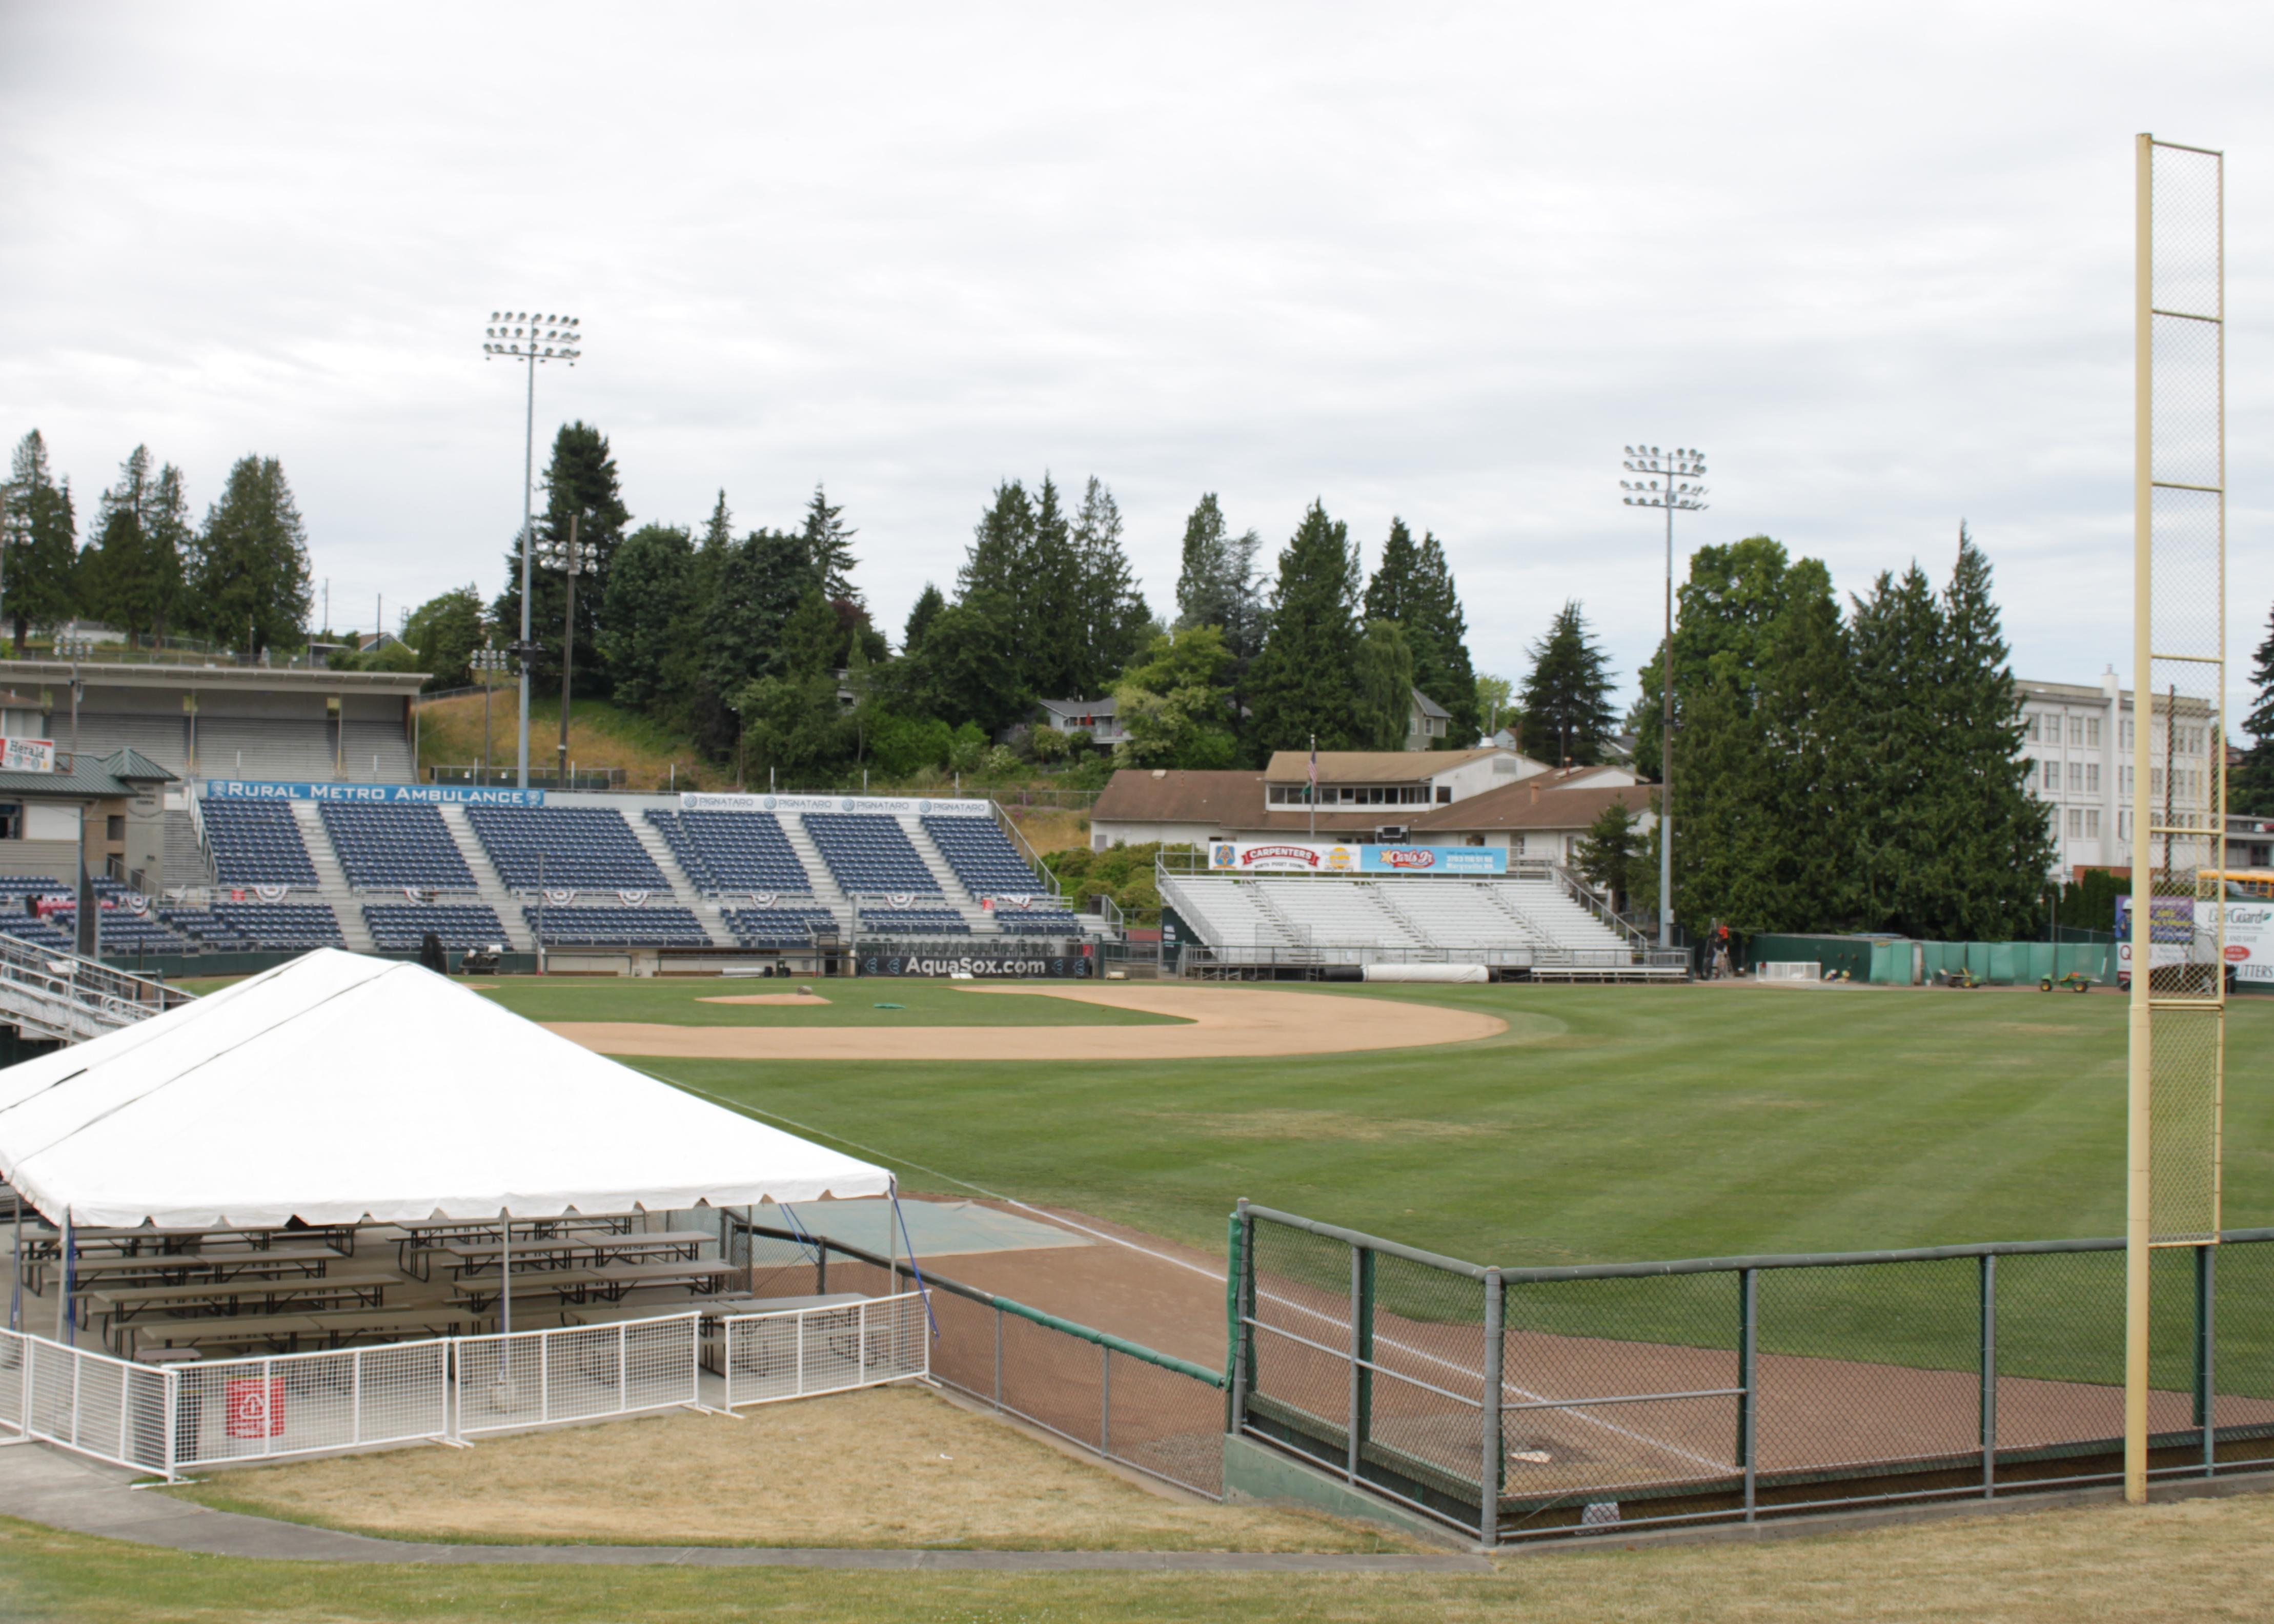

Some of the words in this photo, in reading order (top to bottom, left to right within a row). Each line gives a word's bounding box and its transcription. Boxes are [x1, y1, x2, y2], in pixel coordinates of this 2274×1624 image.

[9, 740, 45, 759] Herald
[228, 782, 300, 798] RURAL
[311, 785, 385, 800] METRO
[394, 787, 523, 804] AMBULANCE
[699, 798, 754, 806] PIGNATARO
[779, 800, 832, 808] PIGNATARO
[856, 802, 909, 810] PIGNATARO
[933, 803, 985, 812] PIGNATARO
[1249, 848, 1313, 860] CARPENTERS
[1390, 850, 1417, 863] Carl's
[2208, 907, 2264, 923] LfGuard
[905, 957, 1045, 976] AquaSox.com
[2236, 964, 2273, 978] UTTERS
